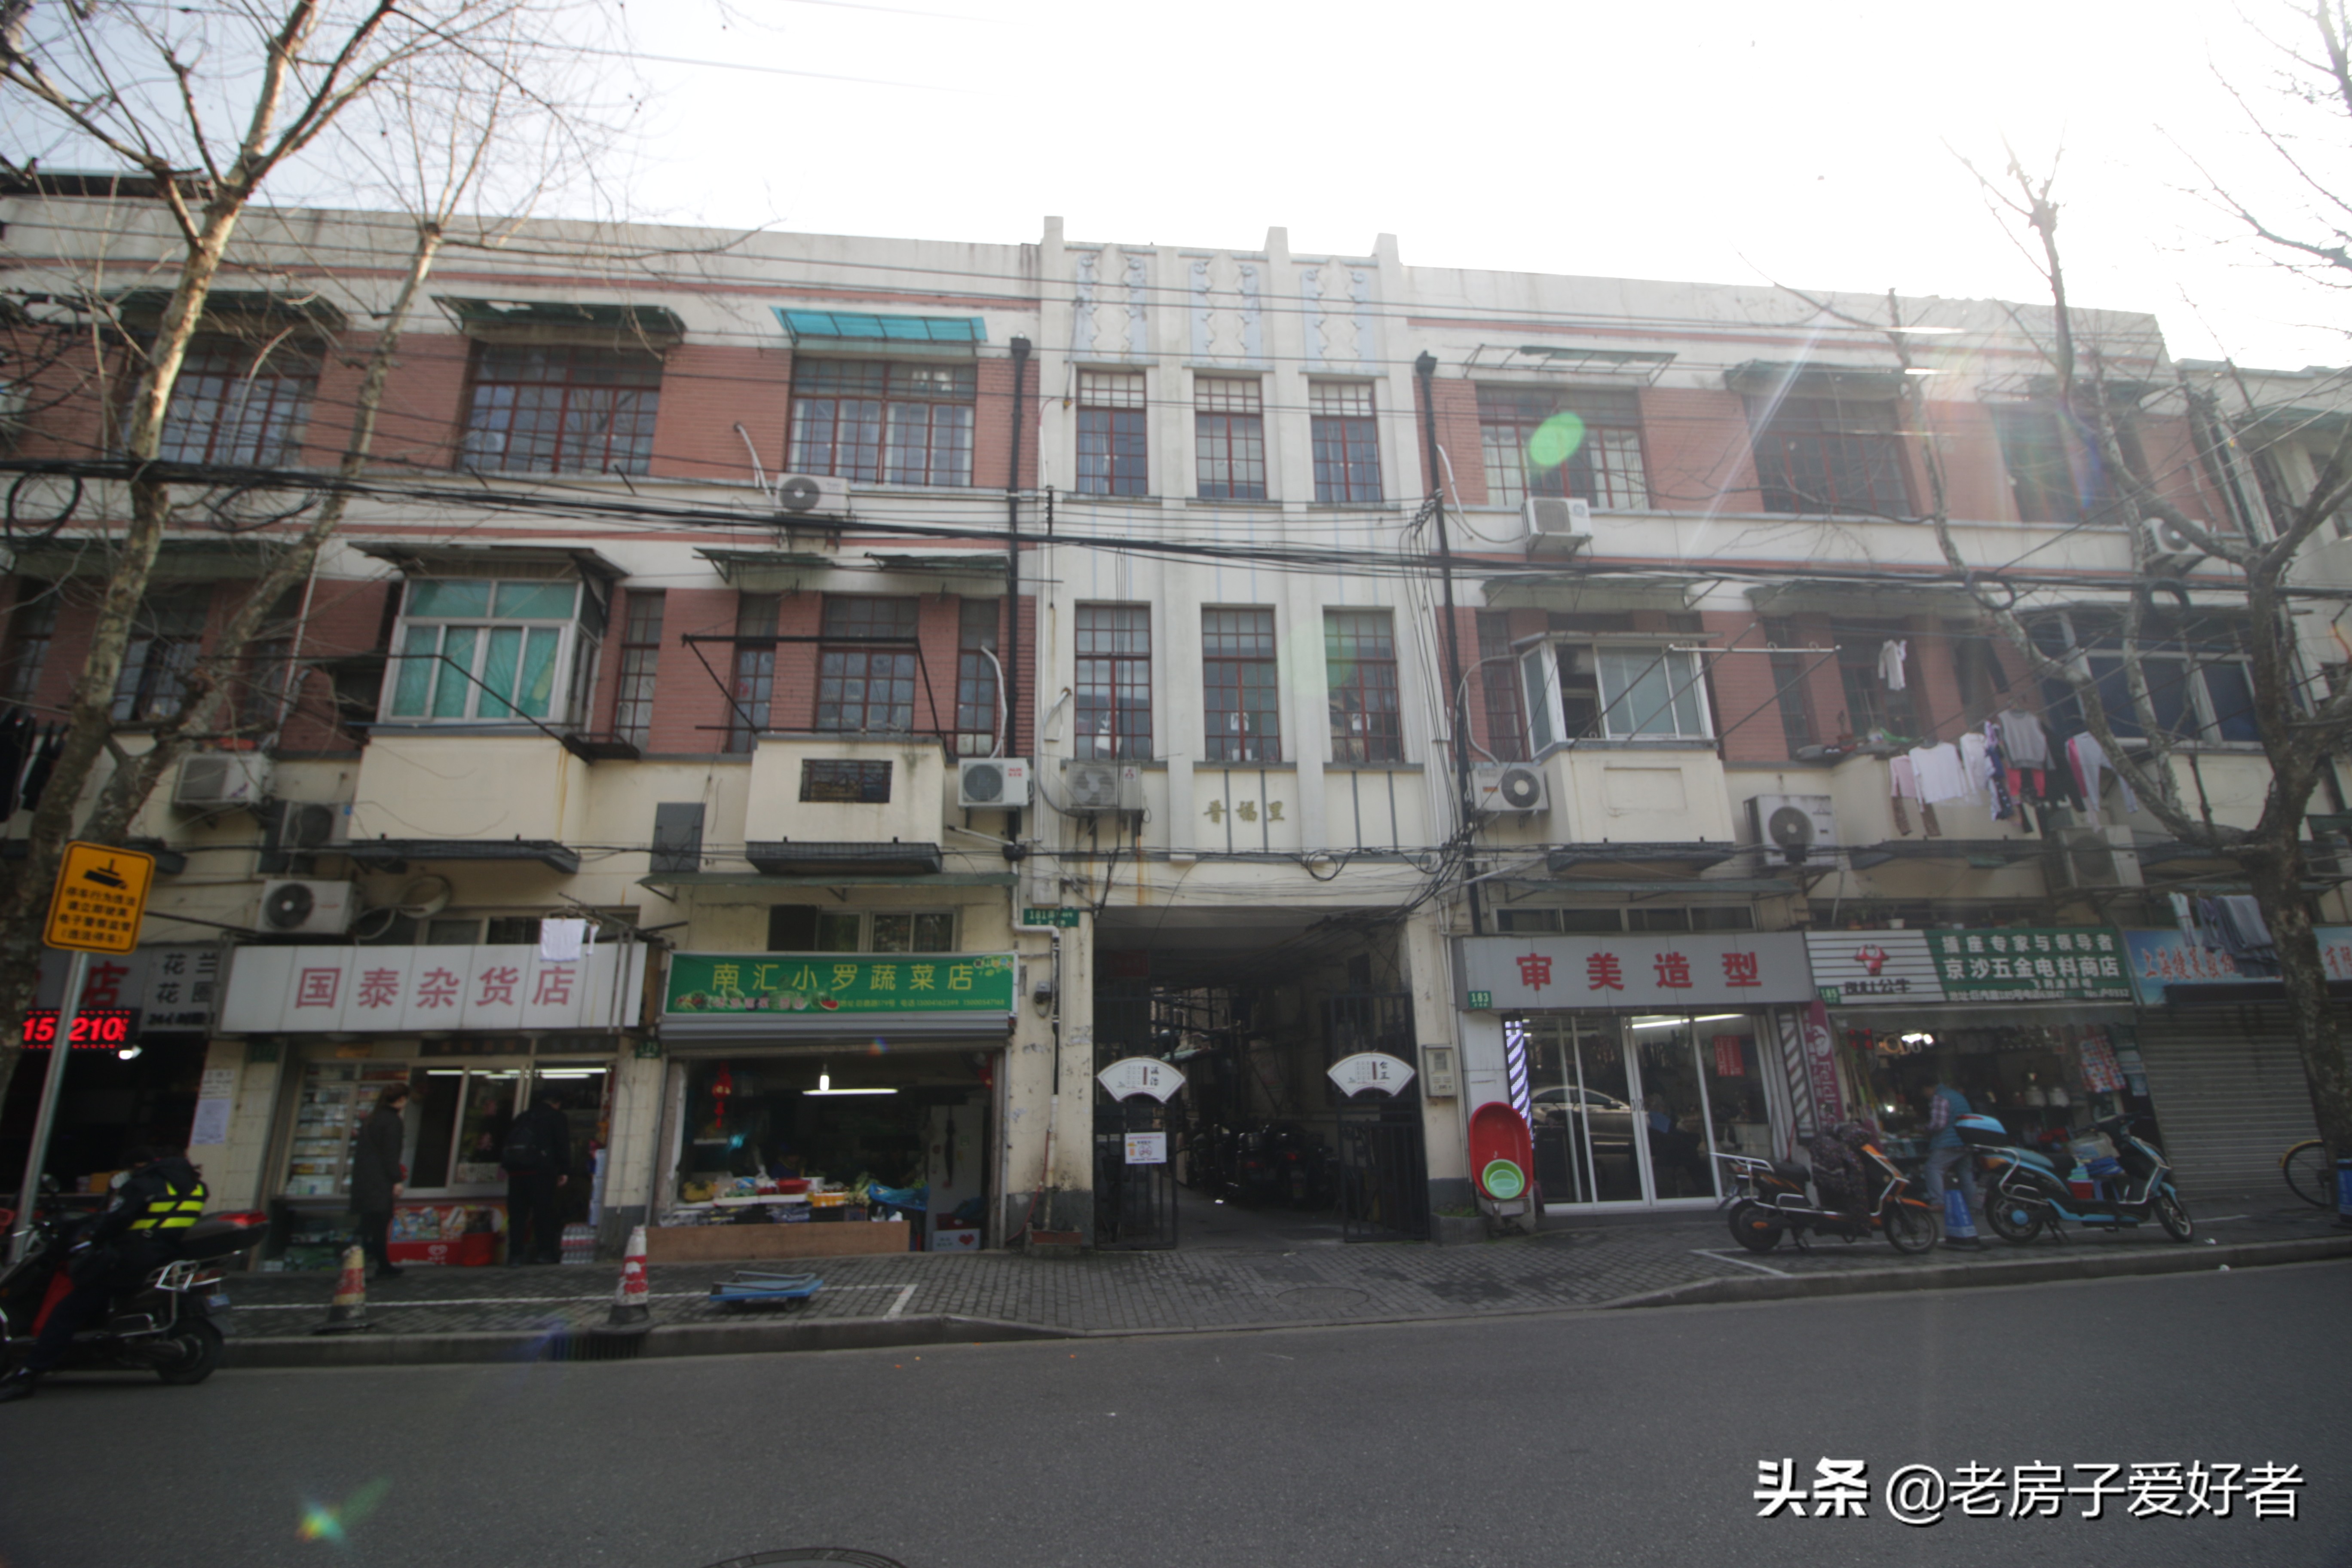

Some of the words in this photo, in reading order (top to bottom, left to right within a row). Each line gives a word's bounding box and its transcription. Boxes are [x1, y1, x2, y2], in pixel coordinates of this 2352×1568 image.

[1942, 934, 2113, 953] 插座专家与领导者
[712, 964, 973, 991] 南汇小罗蔬菜店
[1516, 952, 1762, 991] 审美造型
[1943, 956, 2120, 980] 京沙五金电料商店
[295, 966, 576, 1008] 国泰杂货店
[1471, 992, 1489, 1003] 183
